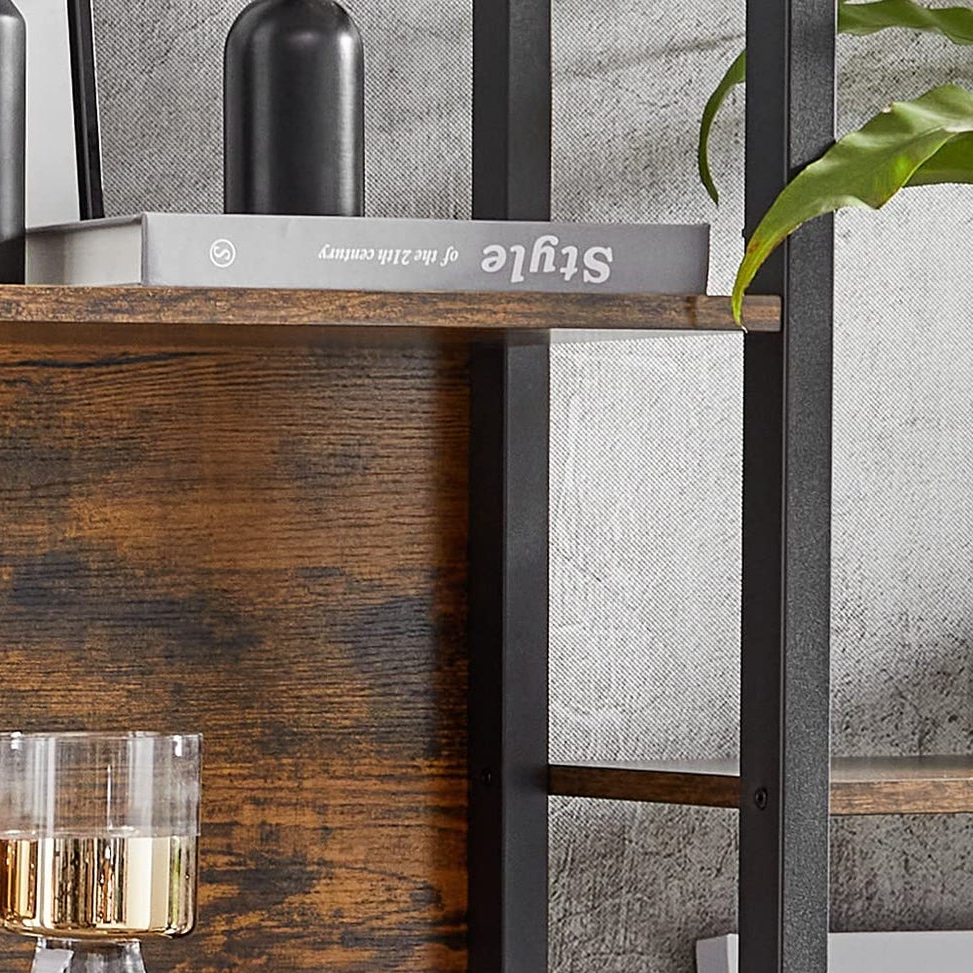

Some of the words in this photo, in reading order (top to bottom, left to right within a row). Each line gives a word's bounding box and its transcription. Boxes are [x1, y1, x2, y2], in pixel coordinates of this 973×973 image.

[318, 243, 375, 262] century
[377, 249, 412, 266] 21th
[413, 249, 438, 266] the
[439, 245, 459, 267] of
[482, 235, 613, 284] Style
